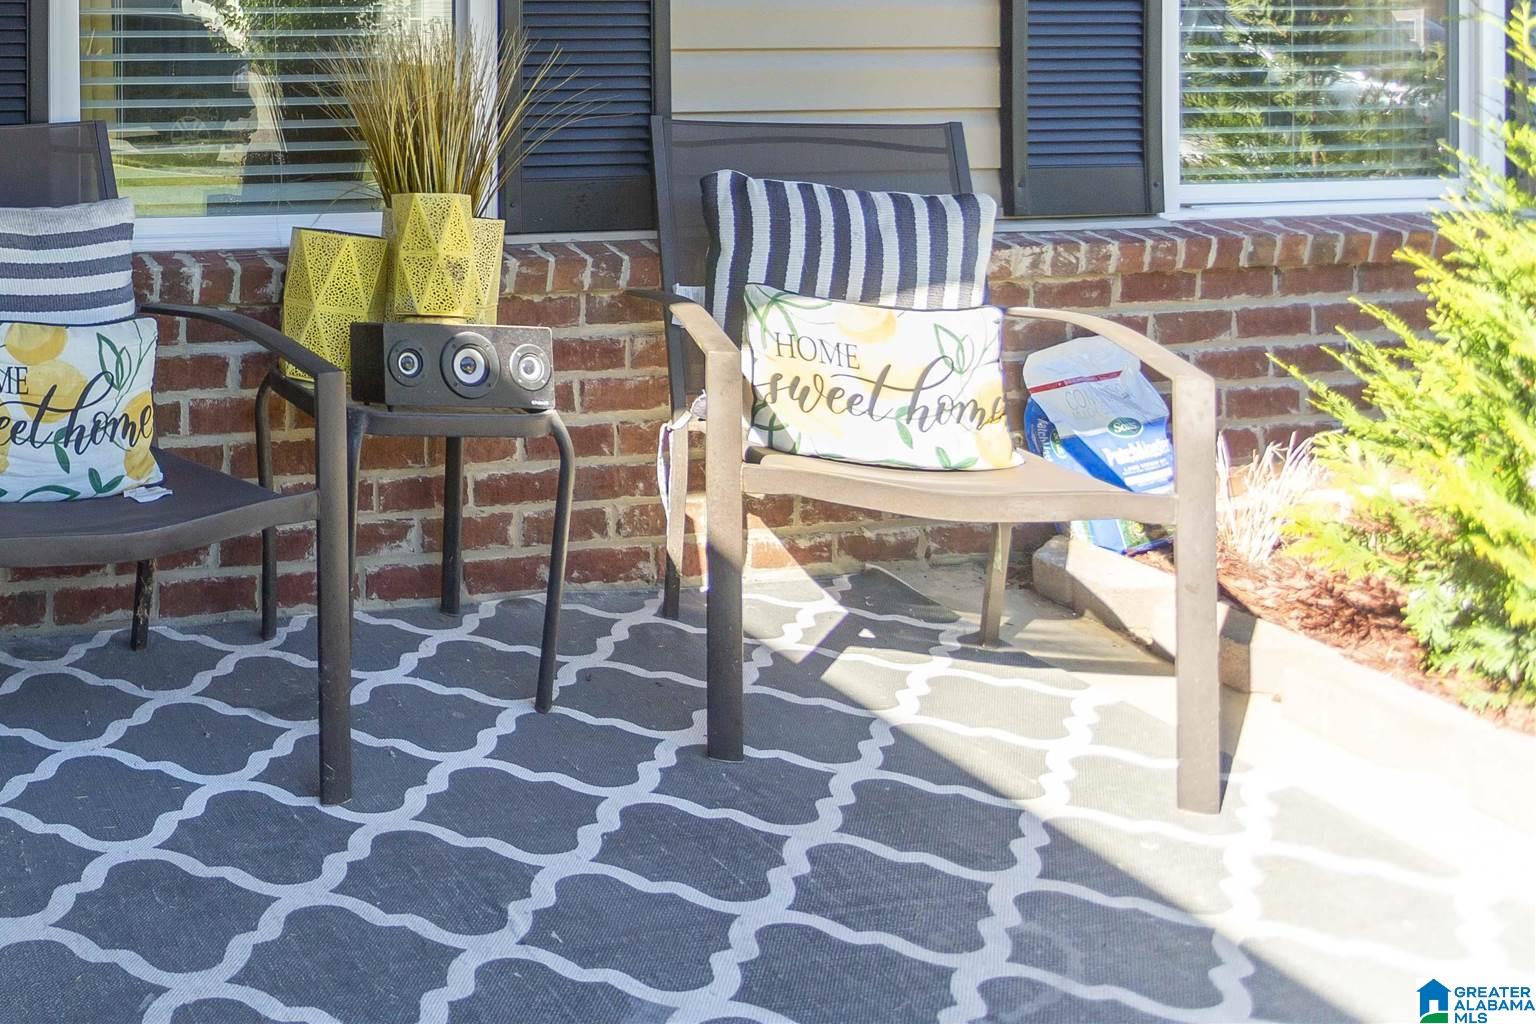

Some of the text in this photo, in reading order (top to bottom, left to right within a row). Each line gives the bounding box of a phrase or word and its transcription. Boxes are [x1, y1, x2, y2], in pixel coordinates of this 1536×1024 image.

[775, 332, 860, 370] HOME
[63, 371, 153, 455] home
[754, 364, 894, 421] sweet
